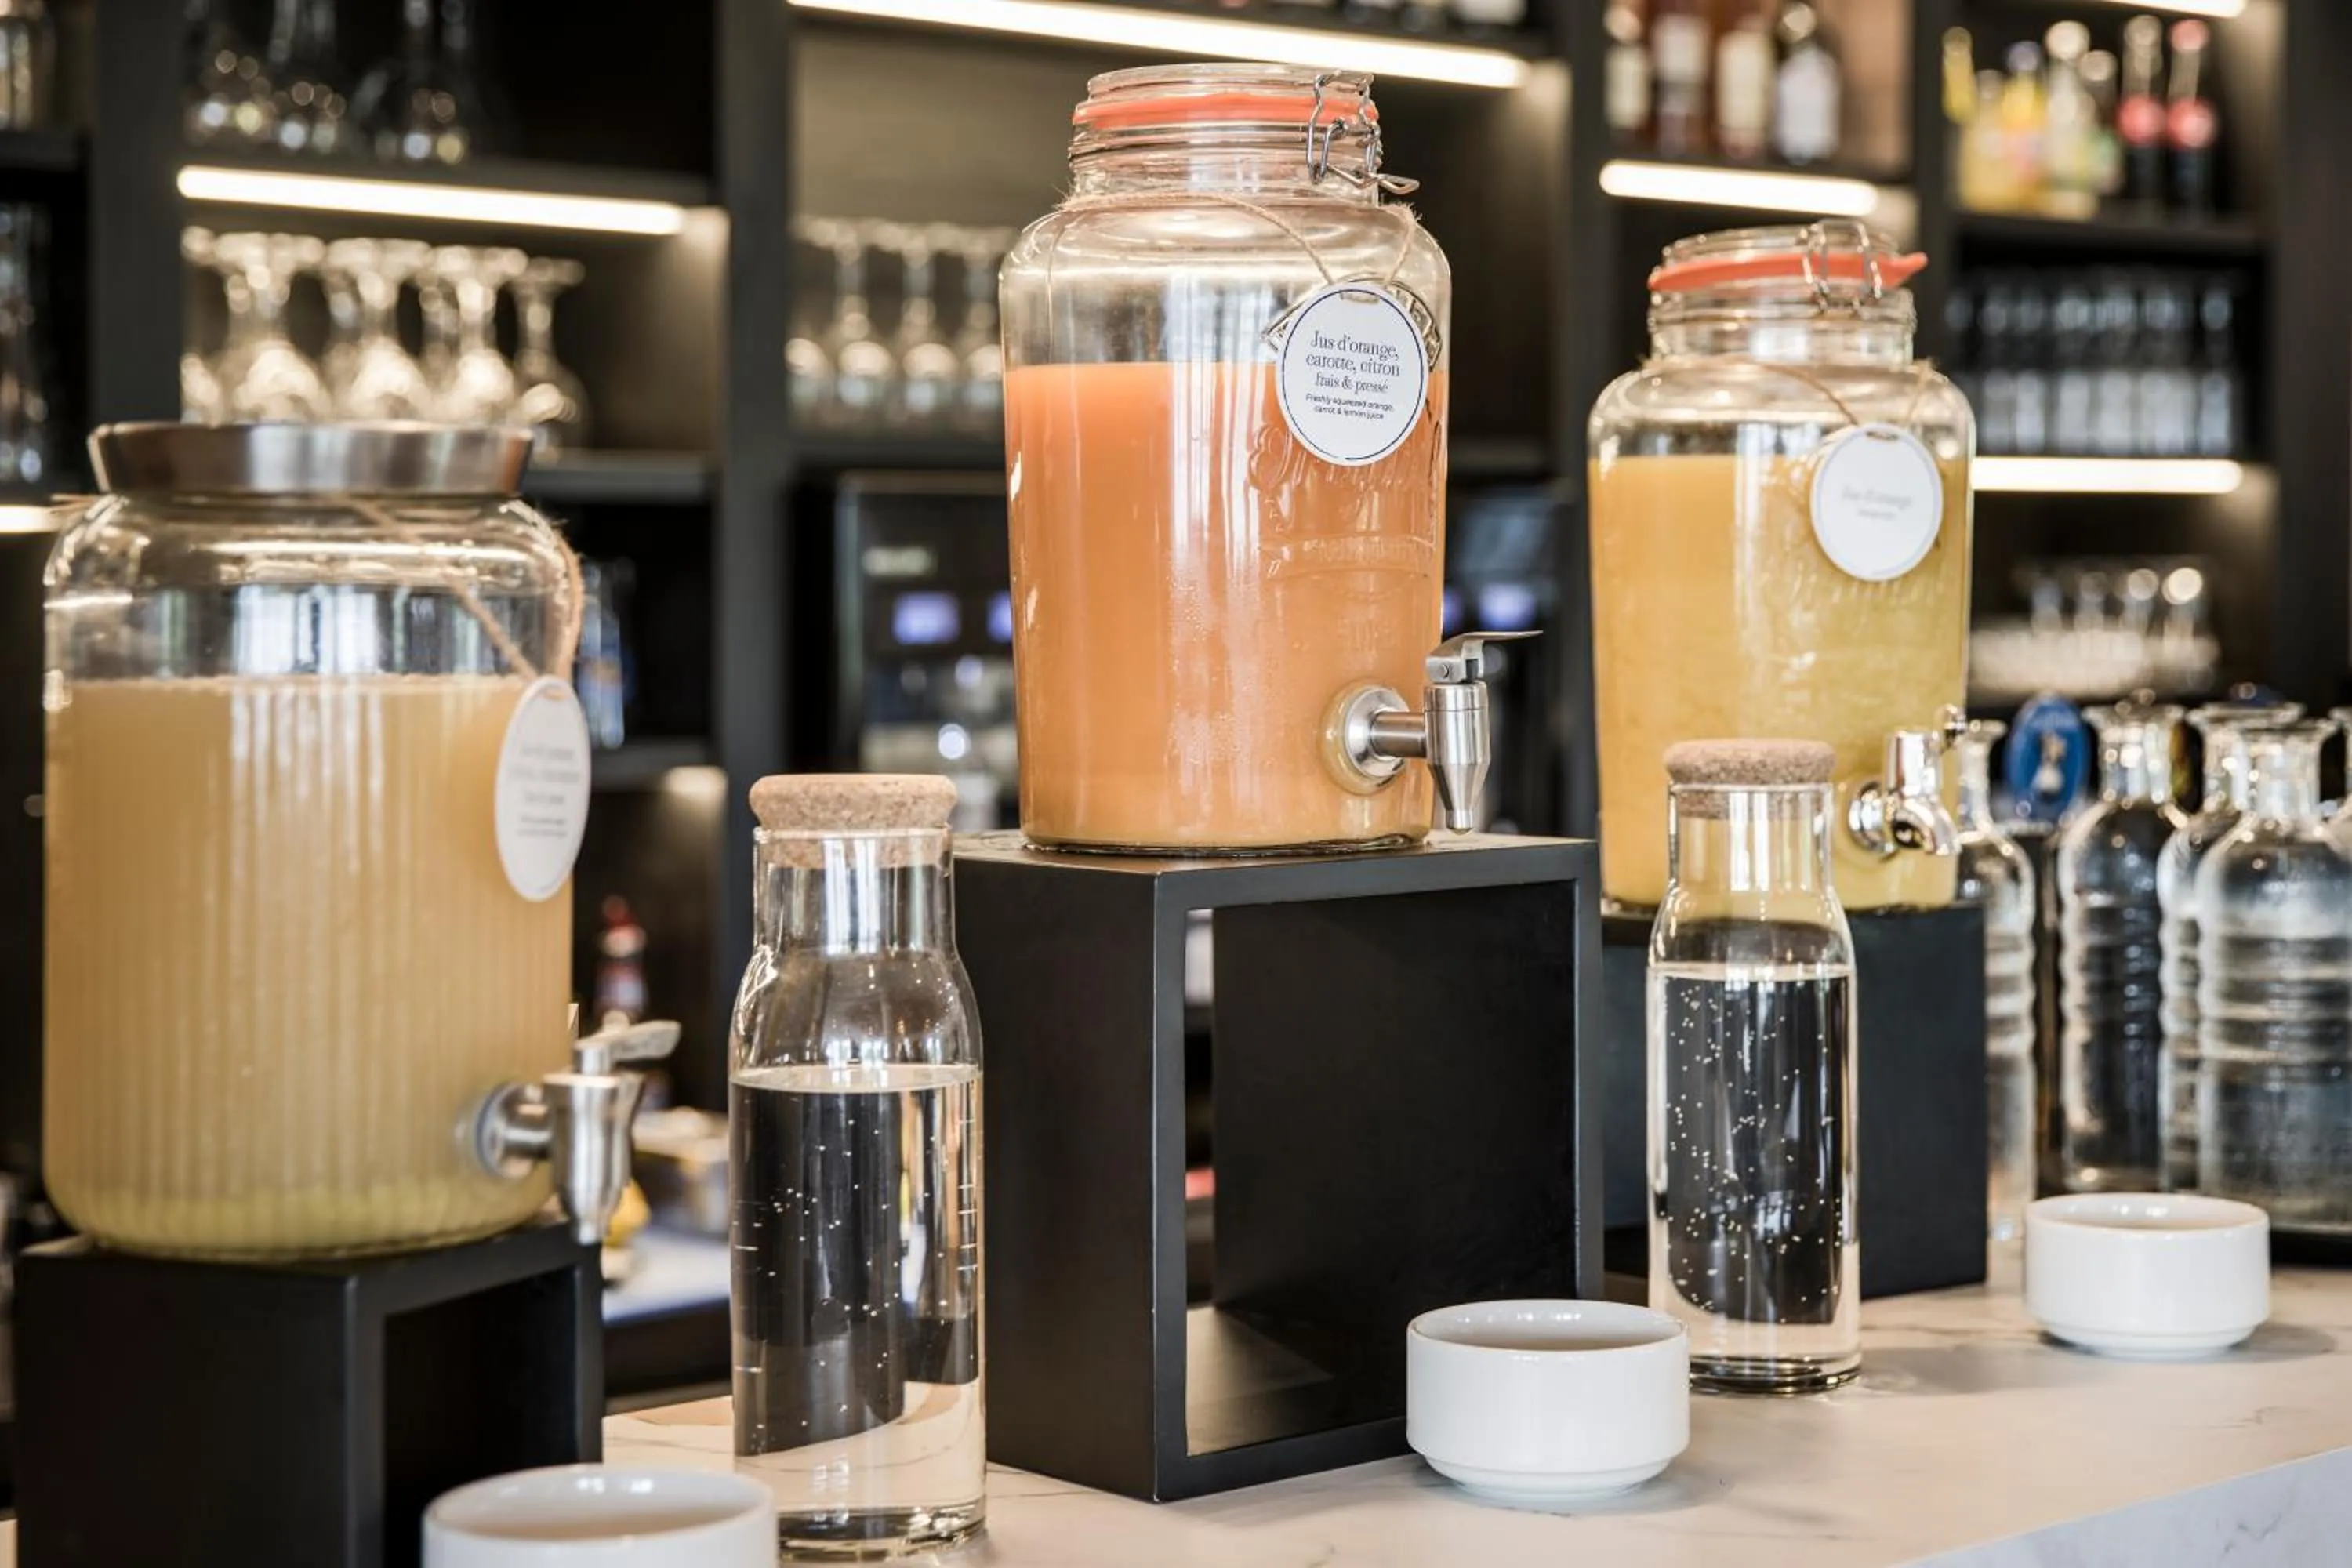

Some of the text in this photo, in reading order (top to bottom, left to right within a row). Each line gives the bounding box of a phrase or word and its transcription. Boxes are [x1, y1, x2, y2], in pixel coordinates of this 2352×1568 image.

[1310, 330, 1399, 361] Jus d'orange,
[1306, 354, 1399, 376] carotte, citron
[1315, 371, 1388, 394] frais & pressé
[1305, 393, 1331, 405] Freshly
[1333, 397, 1367, 408] squeezed
[1313, 405, 1336, 415] carrot
[1343, 408, 1367, 417] lemon
[1367, 410, 1384, 420] juice
